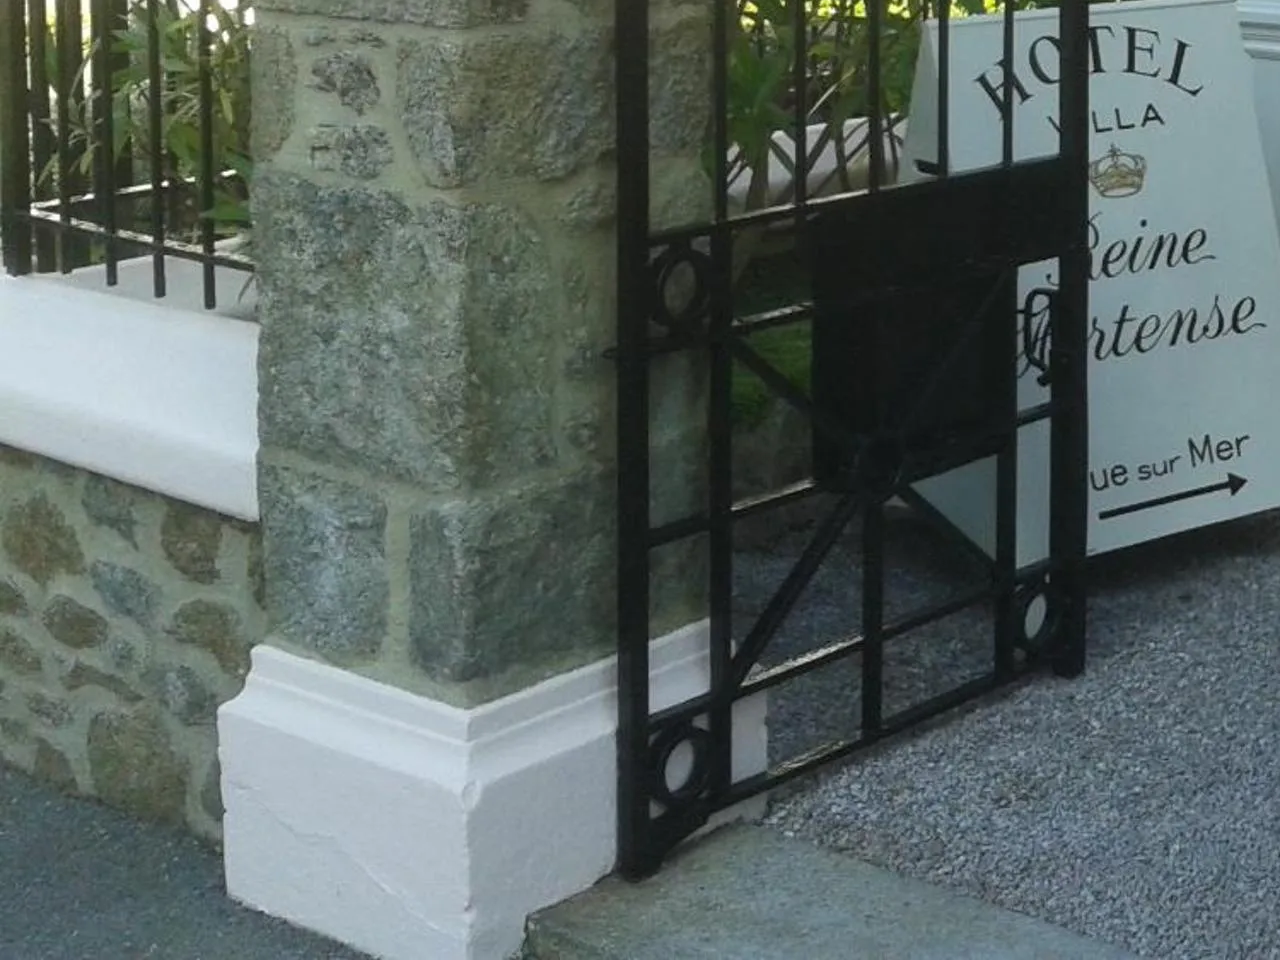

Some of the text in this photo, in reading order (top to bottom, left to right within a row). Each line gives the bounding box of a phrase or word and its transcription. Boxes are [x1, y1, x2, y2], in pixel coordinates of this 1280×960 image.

[974, 25, 1204, 121] HOTEL
[1046, 103, 1165, 134] LLA
[1089, 433, 1251, 492] ue sur Mer
